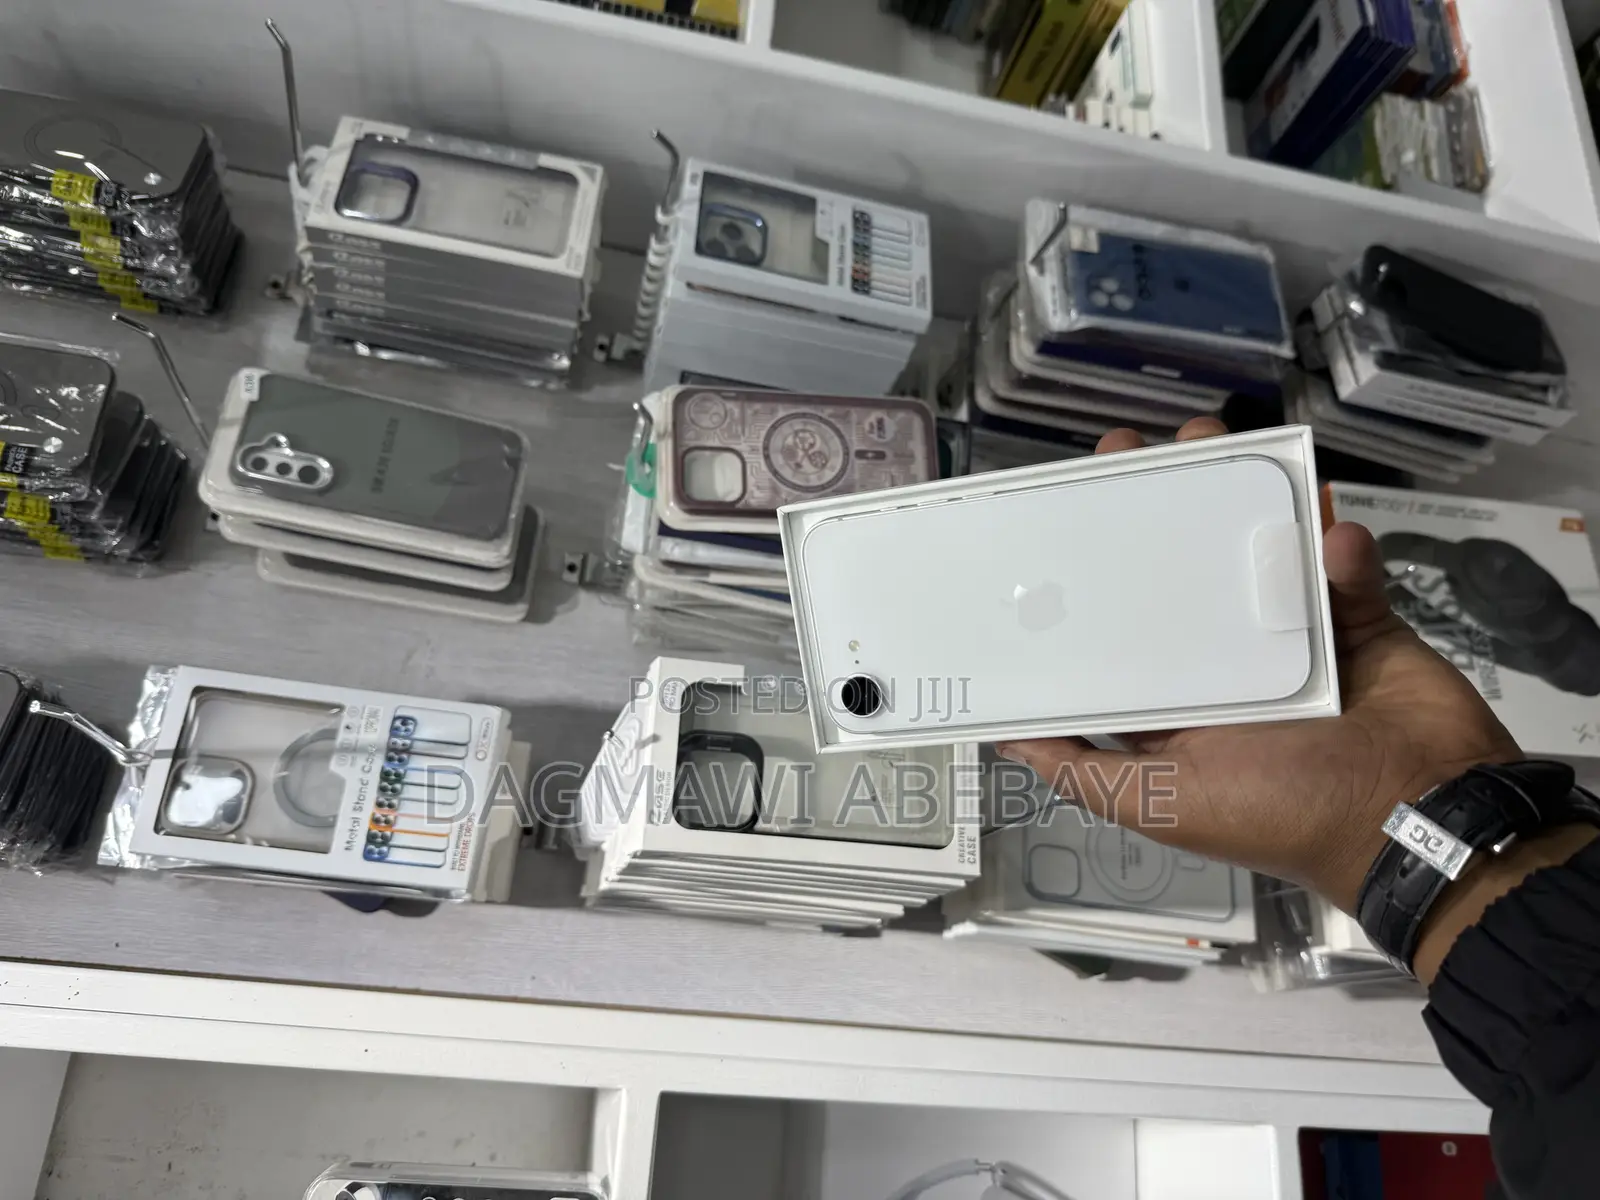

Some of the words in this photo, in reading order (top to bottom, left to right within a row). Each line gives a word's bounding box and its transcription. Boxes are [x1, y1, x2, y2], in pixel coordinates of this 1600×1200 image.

[12, 447, 28, 474] CASE
[345, 817, 361, 852] Metal
[353, 779, 369, 813] Stand
[362, 744, 377, 774] Case
[459, 840, 471, 872] EXTREME
[966, 835, 977, 864] CASE
